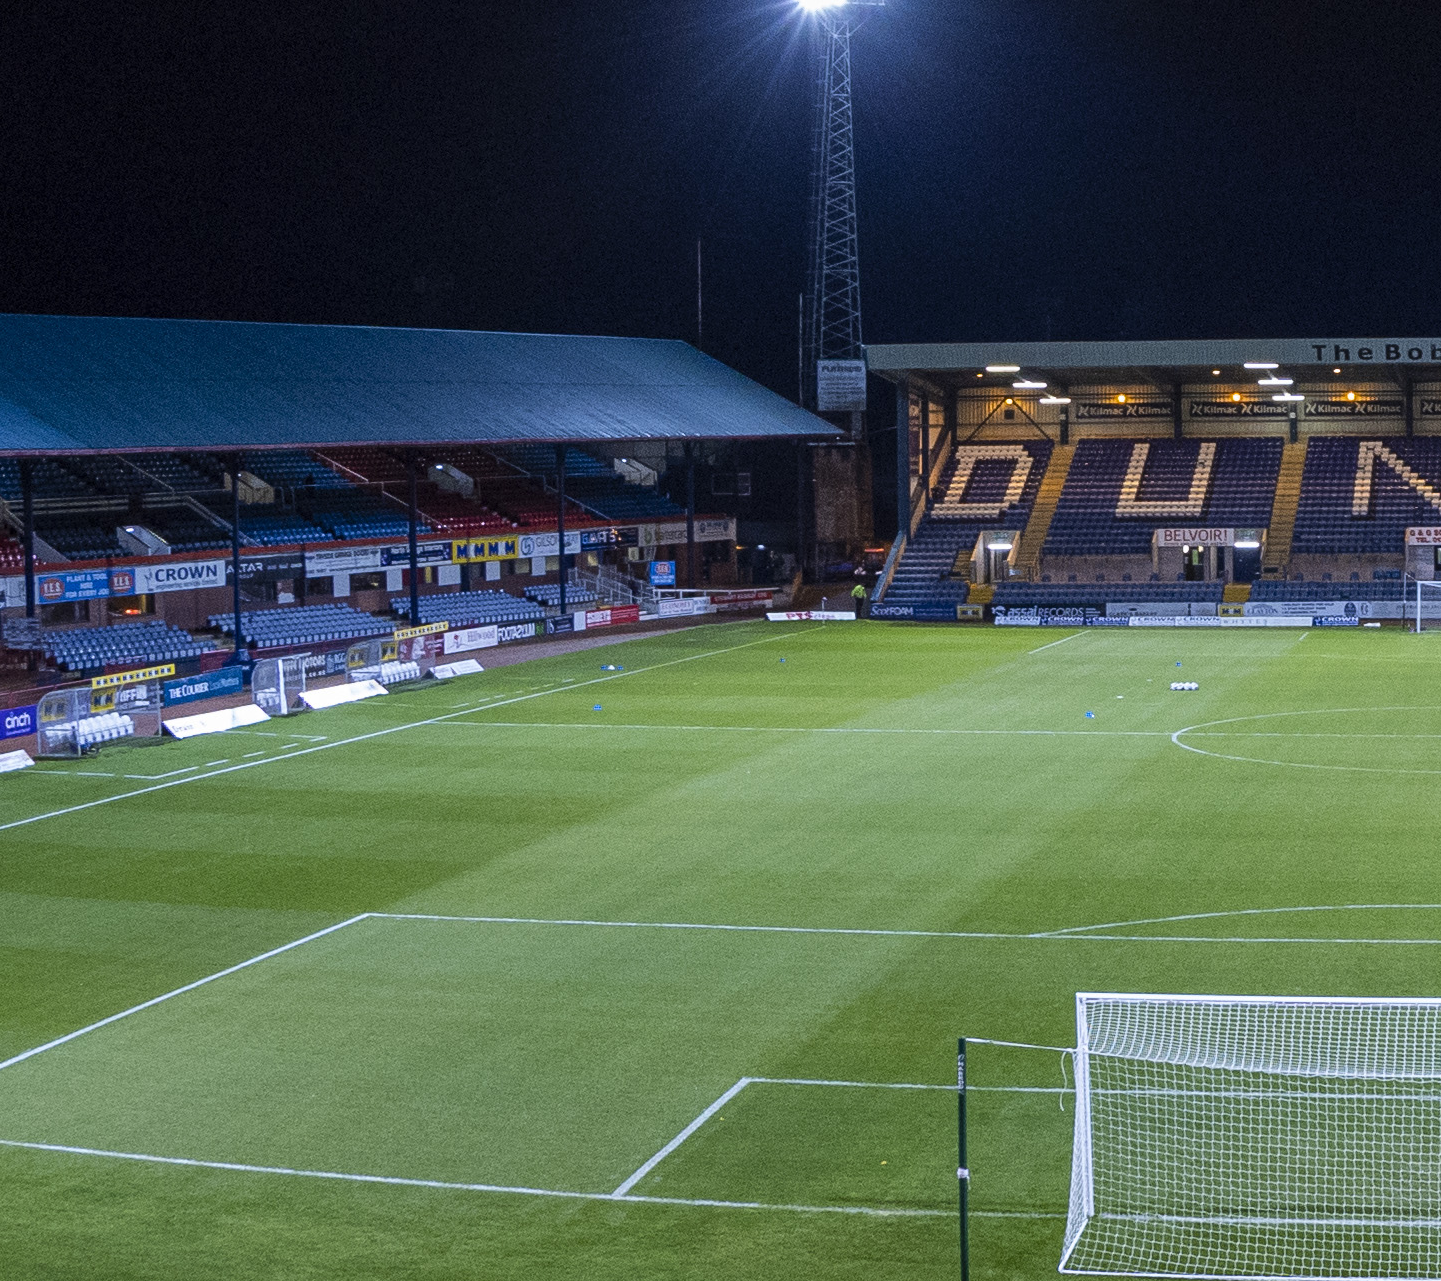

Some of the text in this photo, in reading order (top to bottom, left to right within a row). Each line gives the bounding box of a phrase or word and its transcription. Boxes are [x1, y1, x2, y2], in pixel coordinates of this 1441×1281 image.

[1311, 344, 1374, 362] The
[1090, 405, 1171, 416] Kilmac Kilmac
[1204, 404, 1287, 415] Kilmac Kilmac
[1318, 403, 1401, 414] Kilmac Kilmac
[1163, 529, 1228, 542] BELVOIR!
[155, 563, 218, 583] CROWN
[871, 605, 914, 617] ScotFOAM
[169, 681, 210, 699] THE COURIER
[5, 710, 32, 731] cinch
